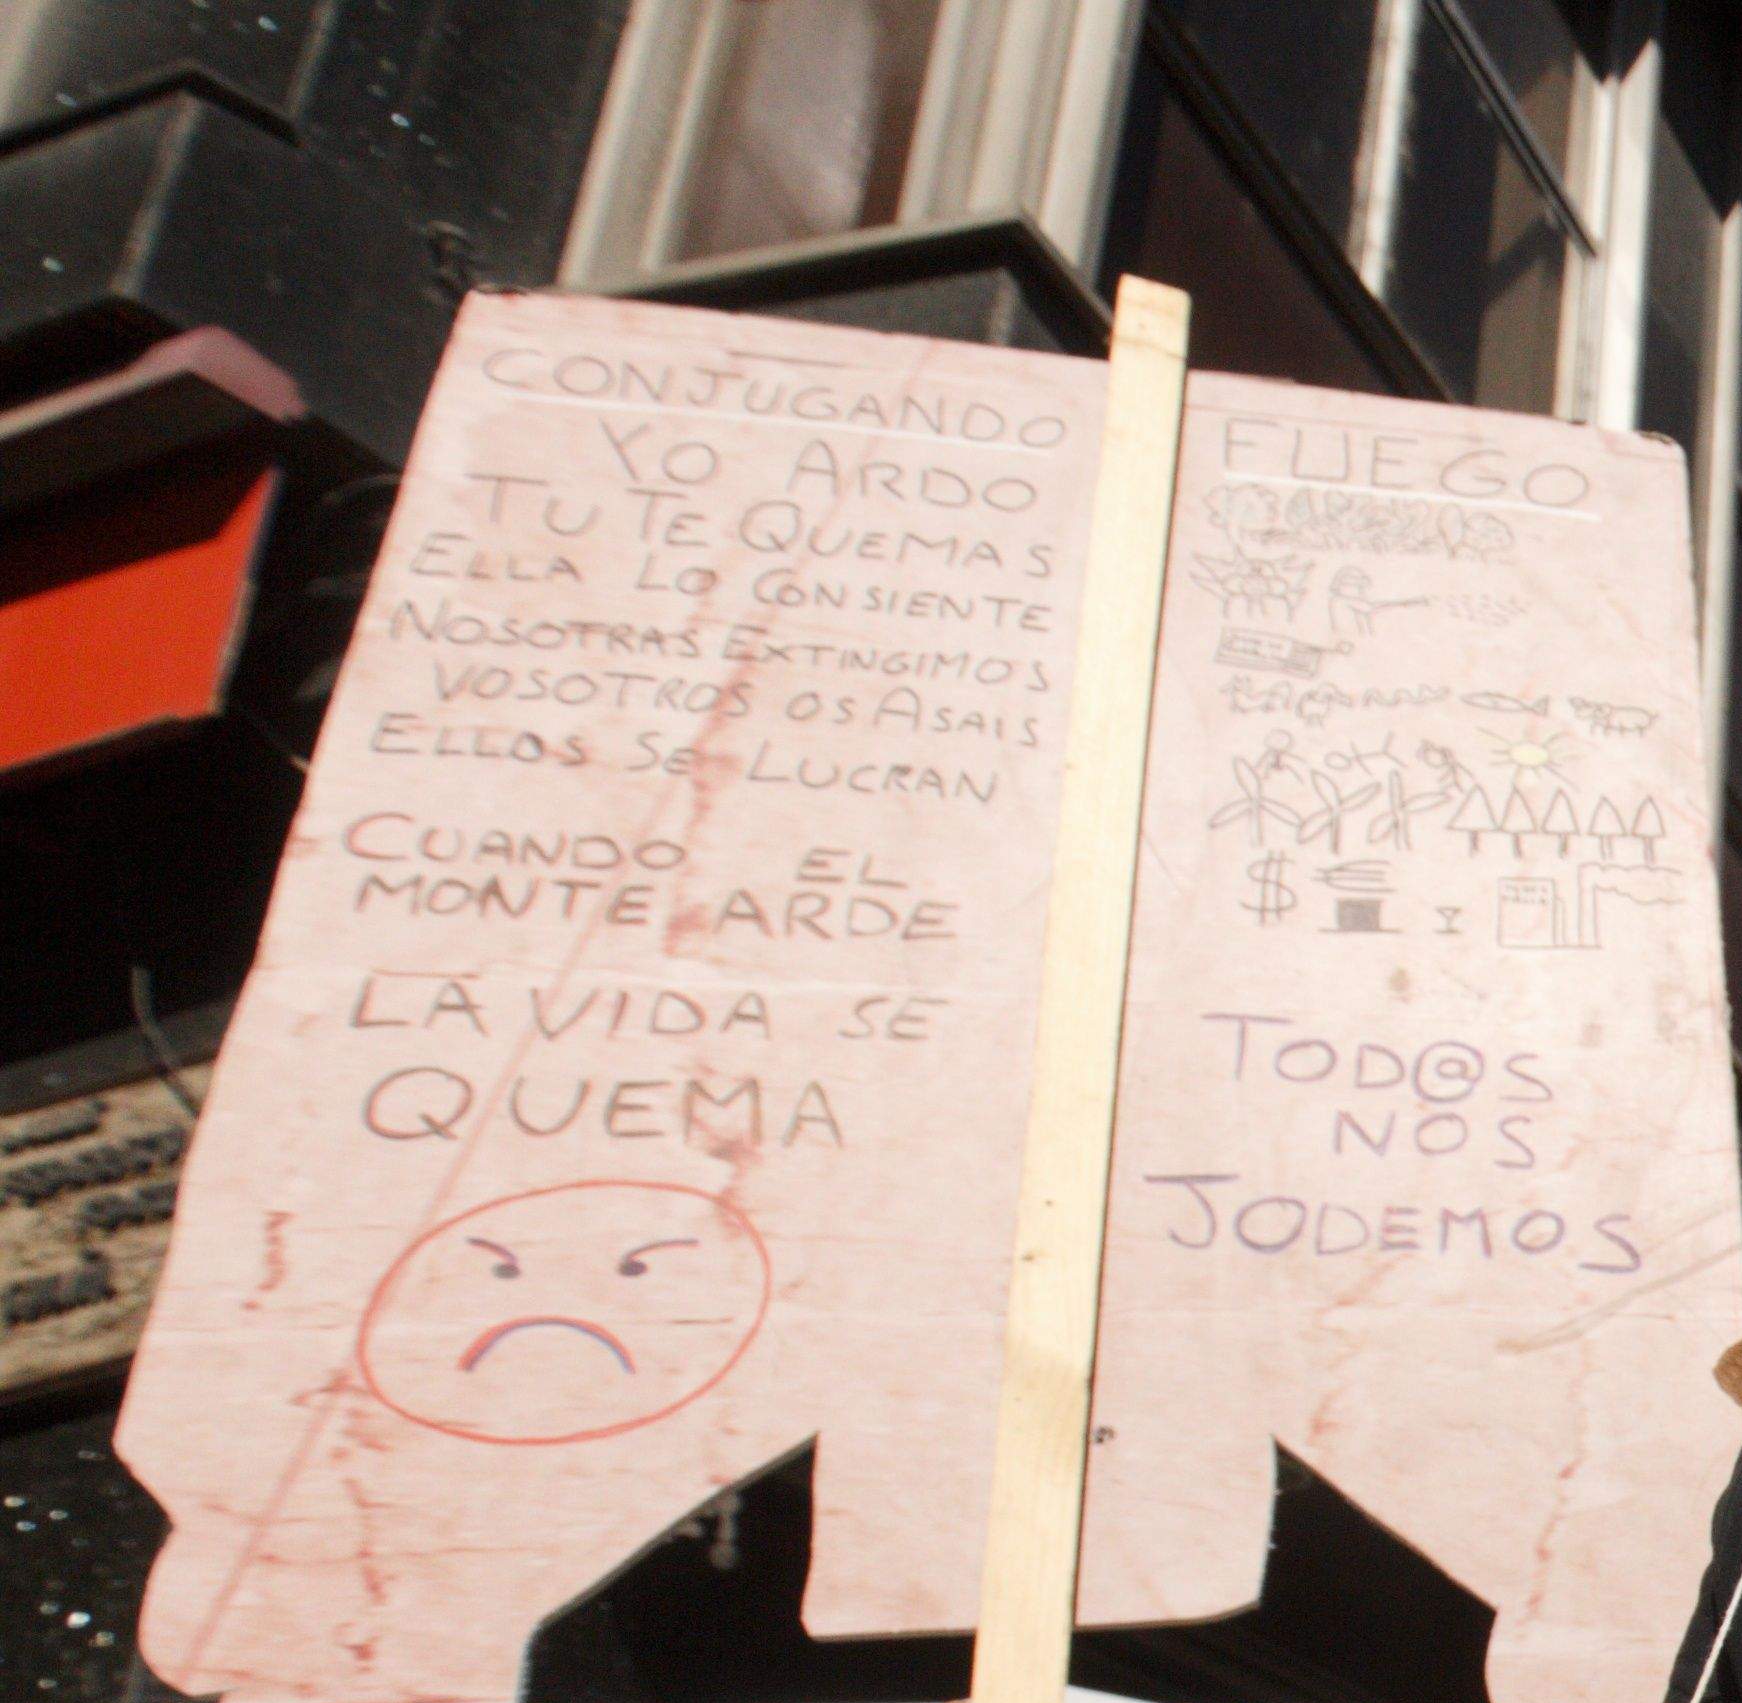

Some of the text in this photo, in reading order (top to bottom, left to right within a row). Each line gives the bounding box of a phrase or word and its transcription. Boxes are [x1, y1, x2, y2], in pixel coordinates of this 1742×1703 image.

[482, 348, 1067, 449] CONJUGANDO
[599, 418, 1038, 513] YO ARDO
[1224, 418, 1590, 506] FUEGO
[466, 473, 1055, 579] TU TE QUEMAS
[410, 532, 1052, 634] ELLA LO CONSIENTE
[389, 600, 1050, 693] NOSOTRAS EXTINGIMOS
[433, 663, 1042, 748] VOSOTROS OS ASAIS
[371, 713, 999, 804] ELLOS SE LUCRAN
[343, 812, 909, 889] CUANDO EL
[355, 874, 960, 941] MONTE ARDE
[350, 975, 947, 1041] LA VIDA SE
[1200, 1012, 1554, 1104] TOD@S
[362, 1067, 845, 1150] QUEMA
[1332, 1110, 1536, 1170] NOS
[1143, 1172, 1642, 1273] JODEMOS
